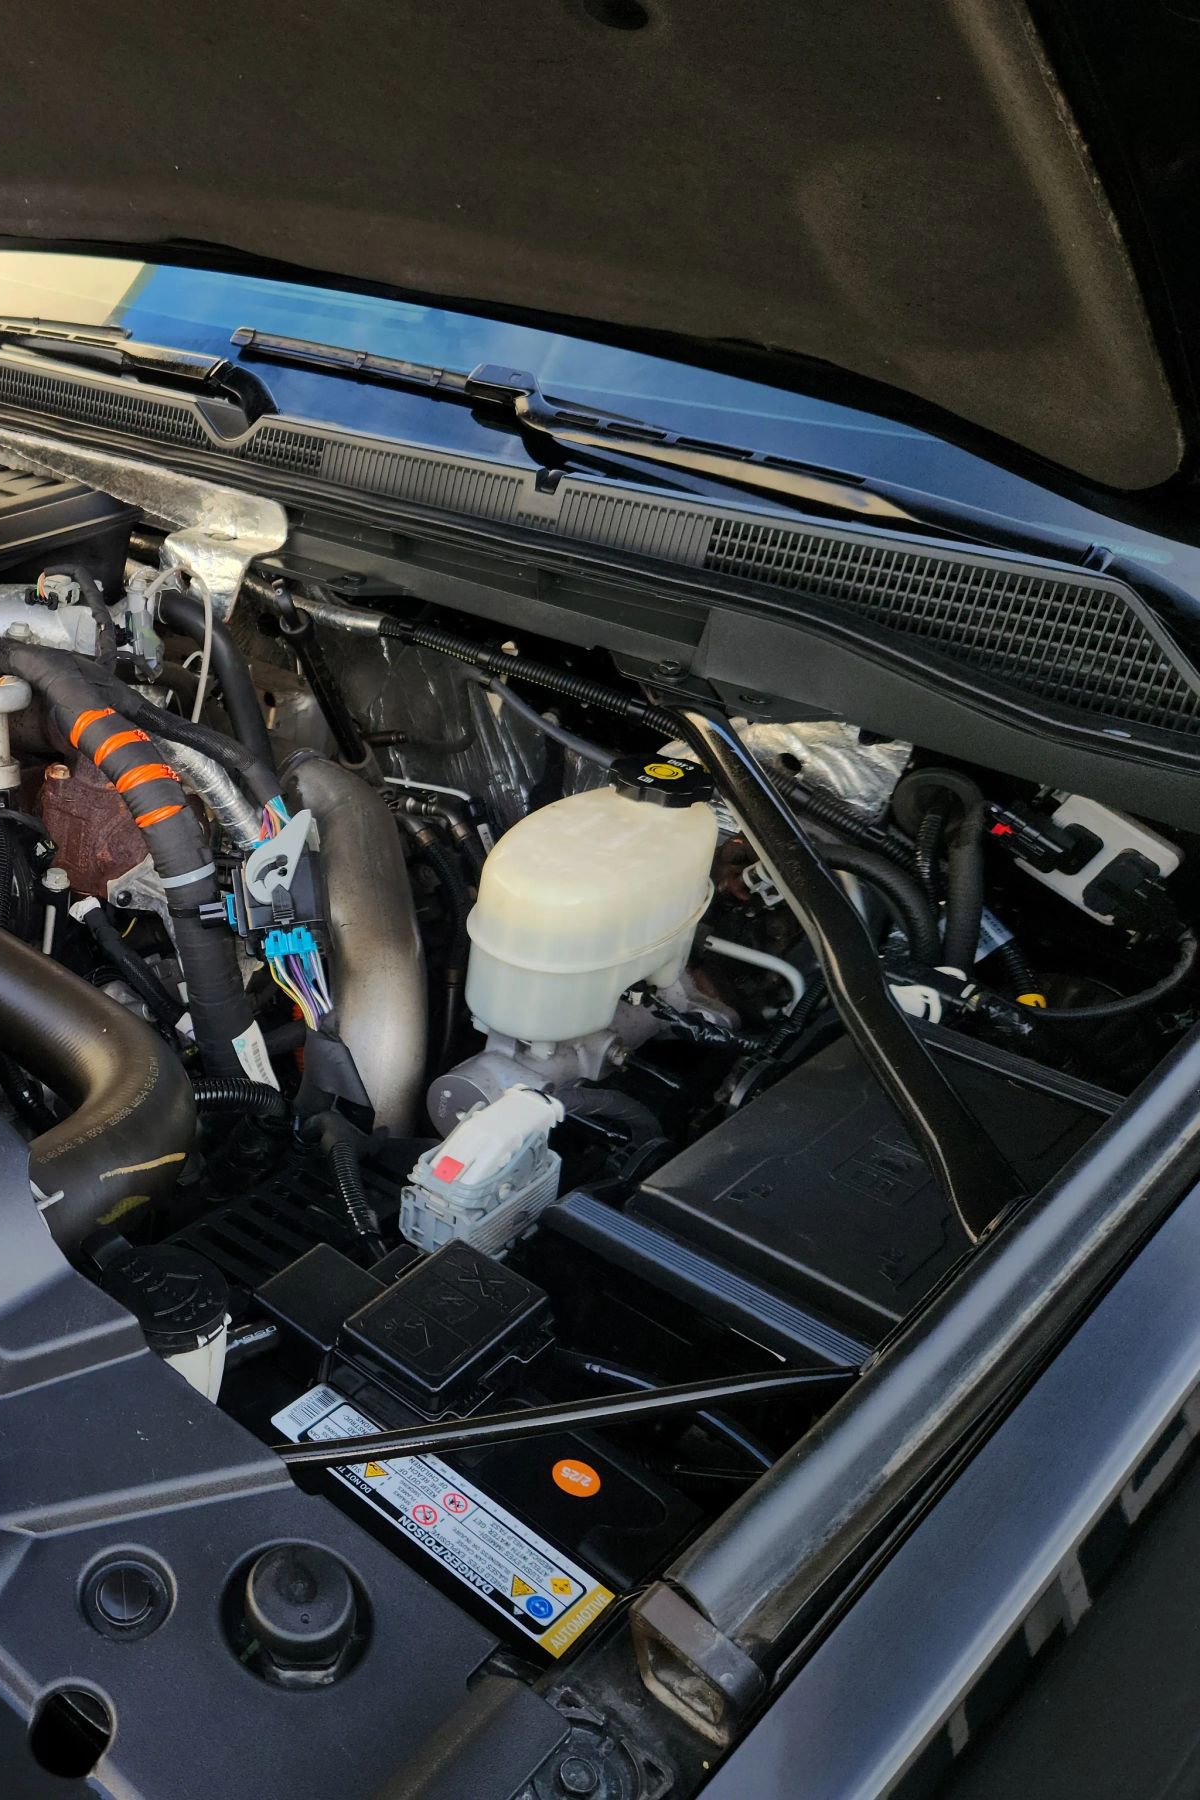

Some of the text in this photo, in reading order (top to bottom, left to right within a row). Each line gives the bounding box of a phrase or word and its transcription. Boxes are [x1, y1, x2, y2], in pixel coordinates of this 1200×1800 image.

[344, 1471, 363, 1485] NOT
[406, 1457, 441, 1483] CHILDREN
[406, 1465, 431, 1484] REACH
[357, 1482, 373, 1494] DO
[396, 1466, 439, 1498] KEEP OUT OF
[428, 1481, 444, 1493] THE
[436, 1480, 449, 1489] OF
[471, 1516, 488, 1529] GET
[429, 1528, 467, 1559] EXPLOSIVE
[506, 1534, 526, 1550] HELP
[396, 1514, 495, 1595] DANGER/POISON
[454, 1539, 509, 1583] GASES CAN CAUSE
[502, 1549, 523, 1566] EYES
[509, 1545, 530, 1562] WITH
[482, 1571, 509, 1593] SHIELD
[519, 1563, 545, 1584] FLUSH
[547, 1590, 610, 1650] AUTOMOTIVE
